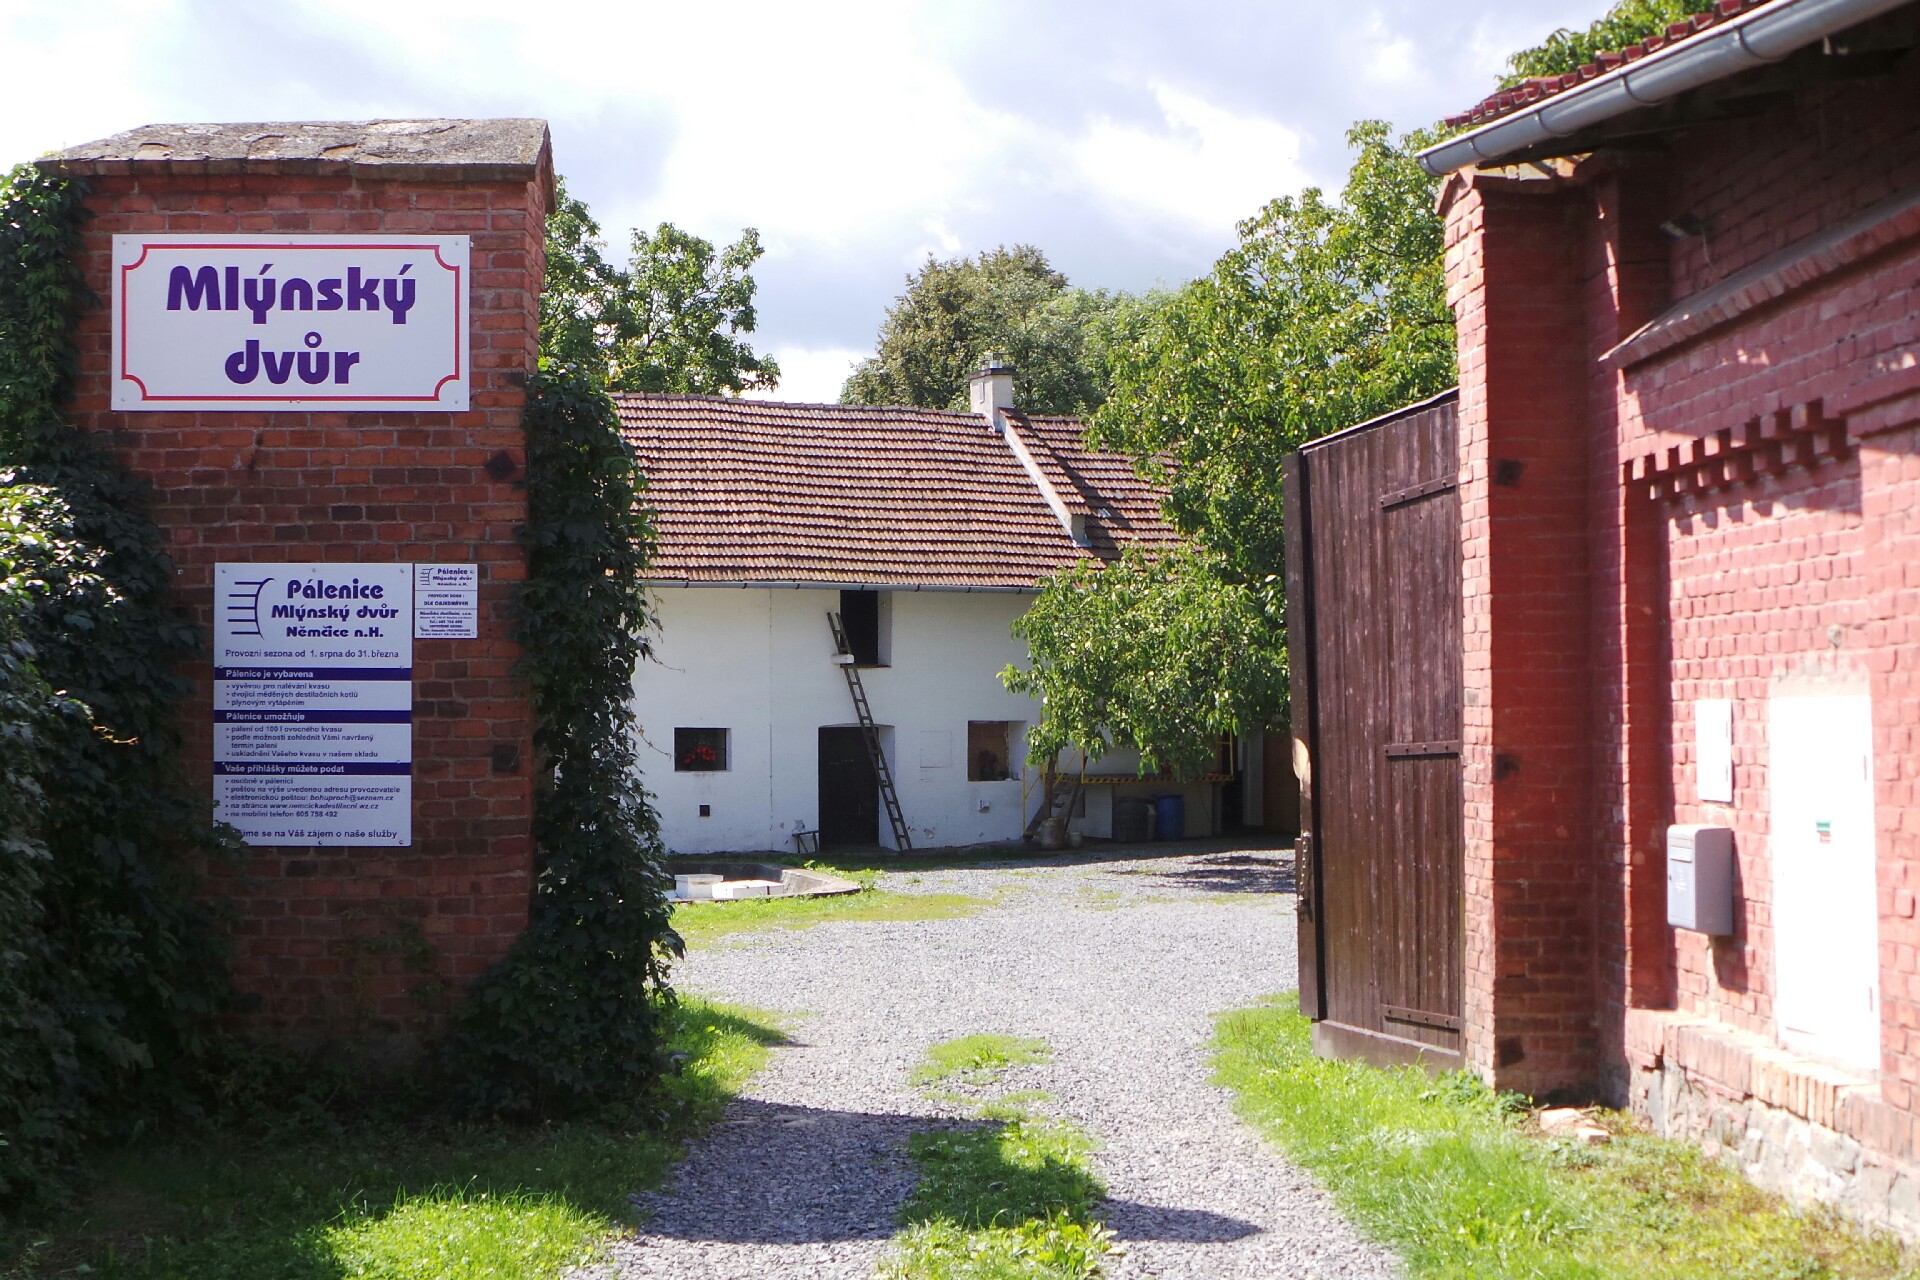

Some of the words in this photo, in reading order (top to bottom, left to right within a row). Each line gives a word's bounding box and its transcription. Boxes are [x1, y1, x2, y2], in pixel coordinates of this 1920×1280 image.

[166, 264, 416, 324] Mlýnský
[224, 332, 360, 384] dvůr
[287, 578, 383, 599] Pálenice
[271, 605, 349, 622] Mlýnský
[357, 603, 399, 618] dvůr
[286, 626, 348, 637] Němčice
[354, 627, 383, 637] n.H.
[225, 649, 261, 657] Provozní
[371, 649, 399, 657] března
[274, 671, 313, 679] vybavena
[264, 713, 305, 722] umožňuje
[247, 765, 285, 774] přihlášky
[320, 766, 344, 774] podat
[307, 830, 333, 839] zájem
[368, 830, 397, 839] služby
